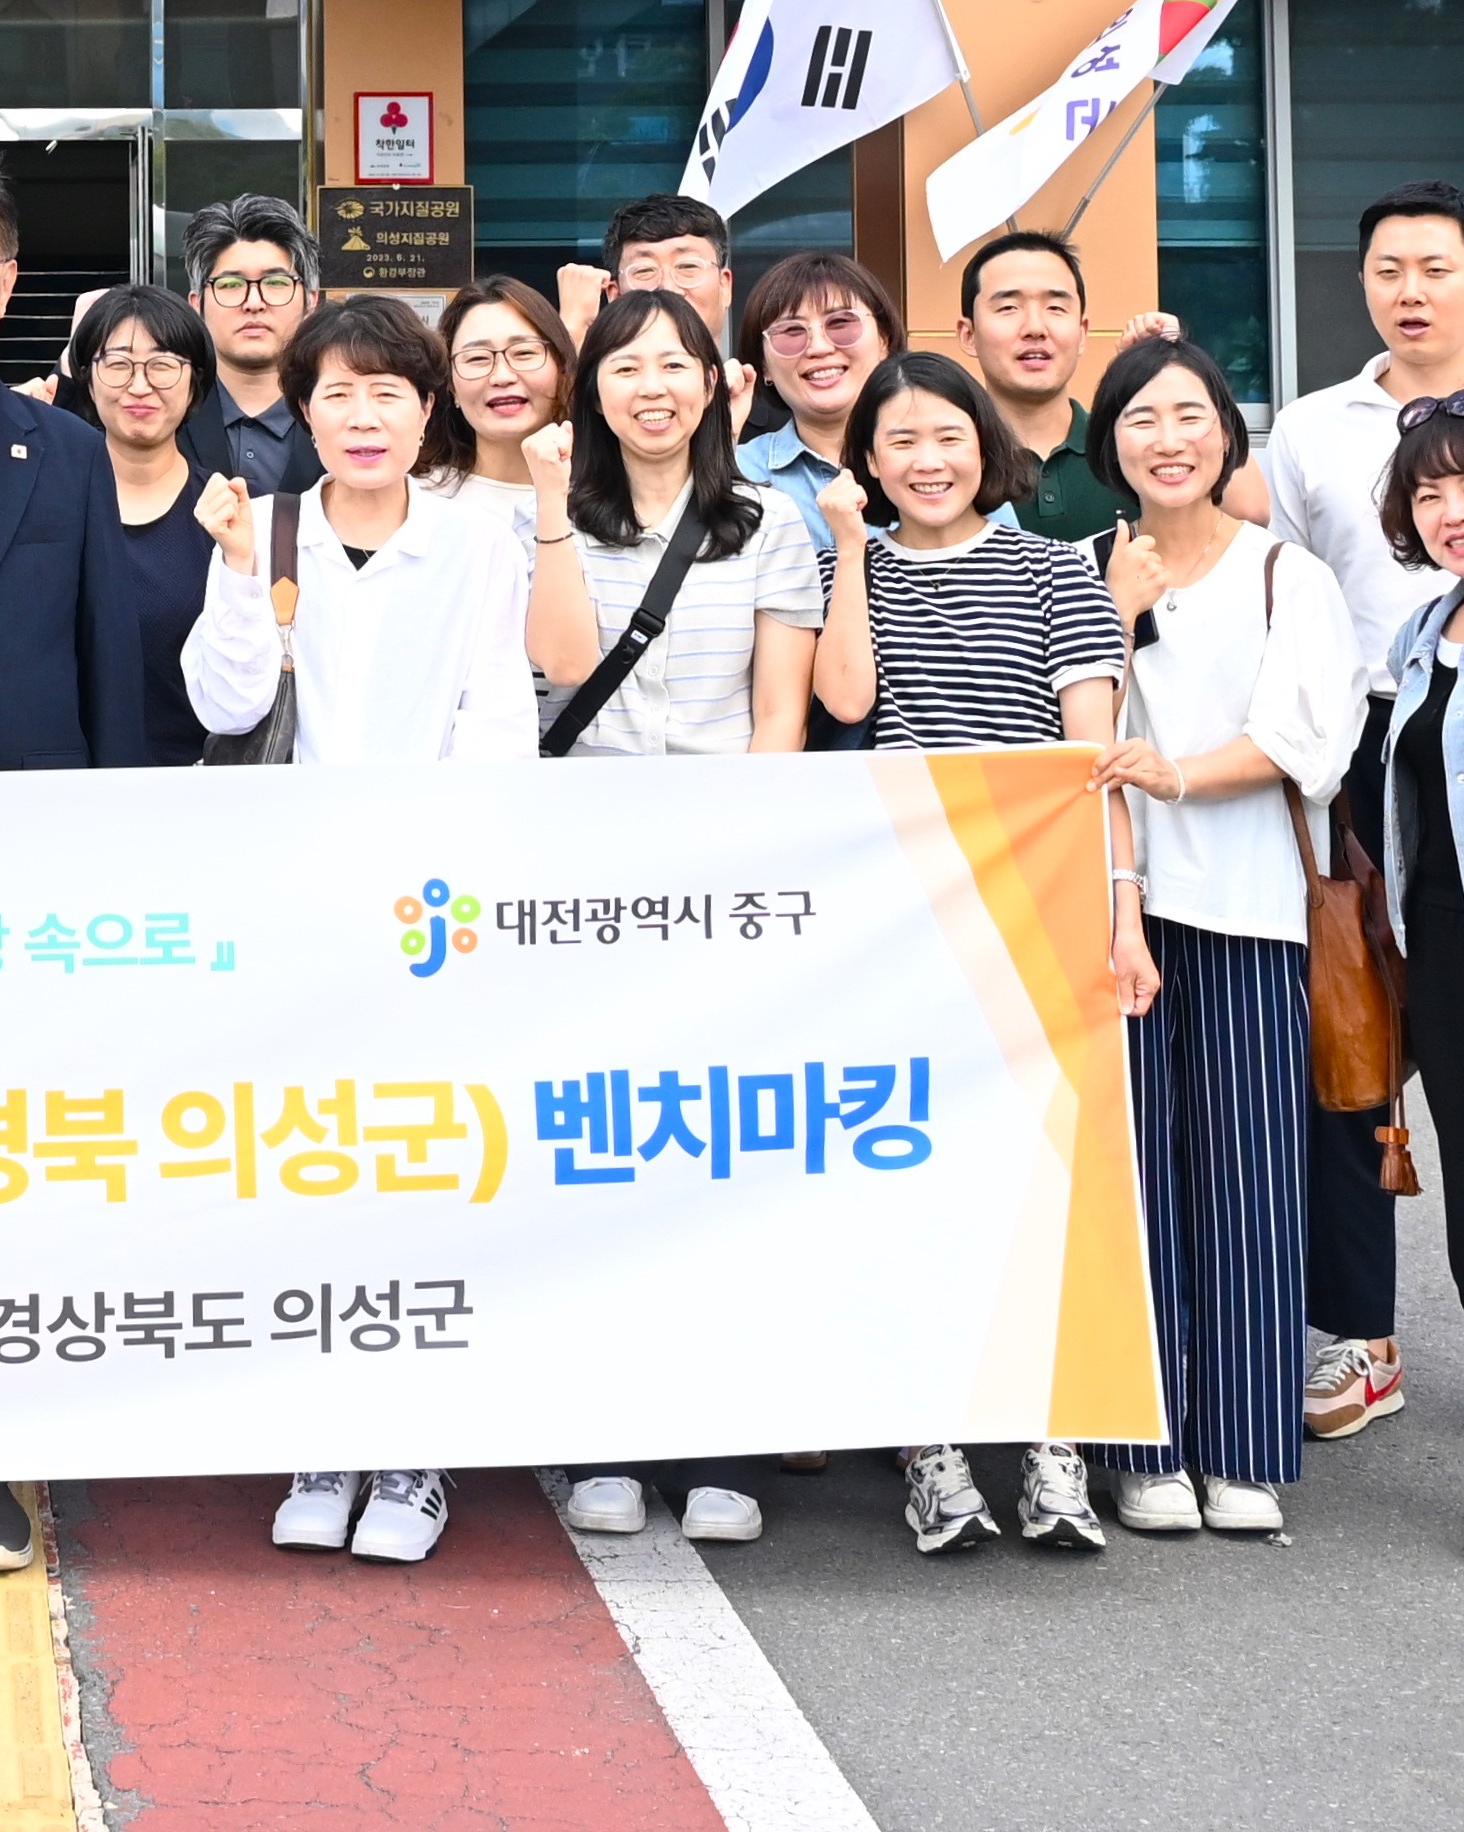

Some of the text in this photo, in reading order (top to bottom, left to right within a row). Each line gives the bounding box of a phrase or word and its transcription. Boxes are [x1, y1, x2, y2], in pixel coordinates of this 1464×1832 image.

[375, 139, 415, 151] 착한일터
[370, 200, 460, 218] 국가지질공원
[376, 231, 450, 246] 의성지질공원
[366, 253, 393, 263] 2023.
[495, 891, 816, 946] 대전광역시 중구
[158, 1078, 510, 1205] 의성군)
[533, 1055, 934, 1187] 벤치마킹
[270, 1279, 474, 1355] 의성군
